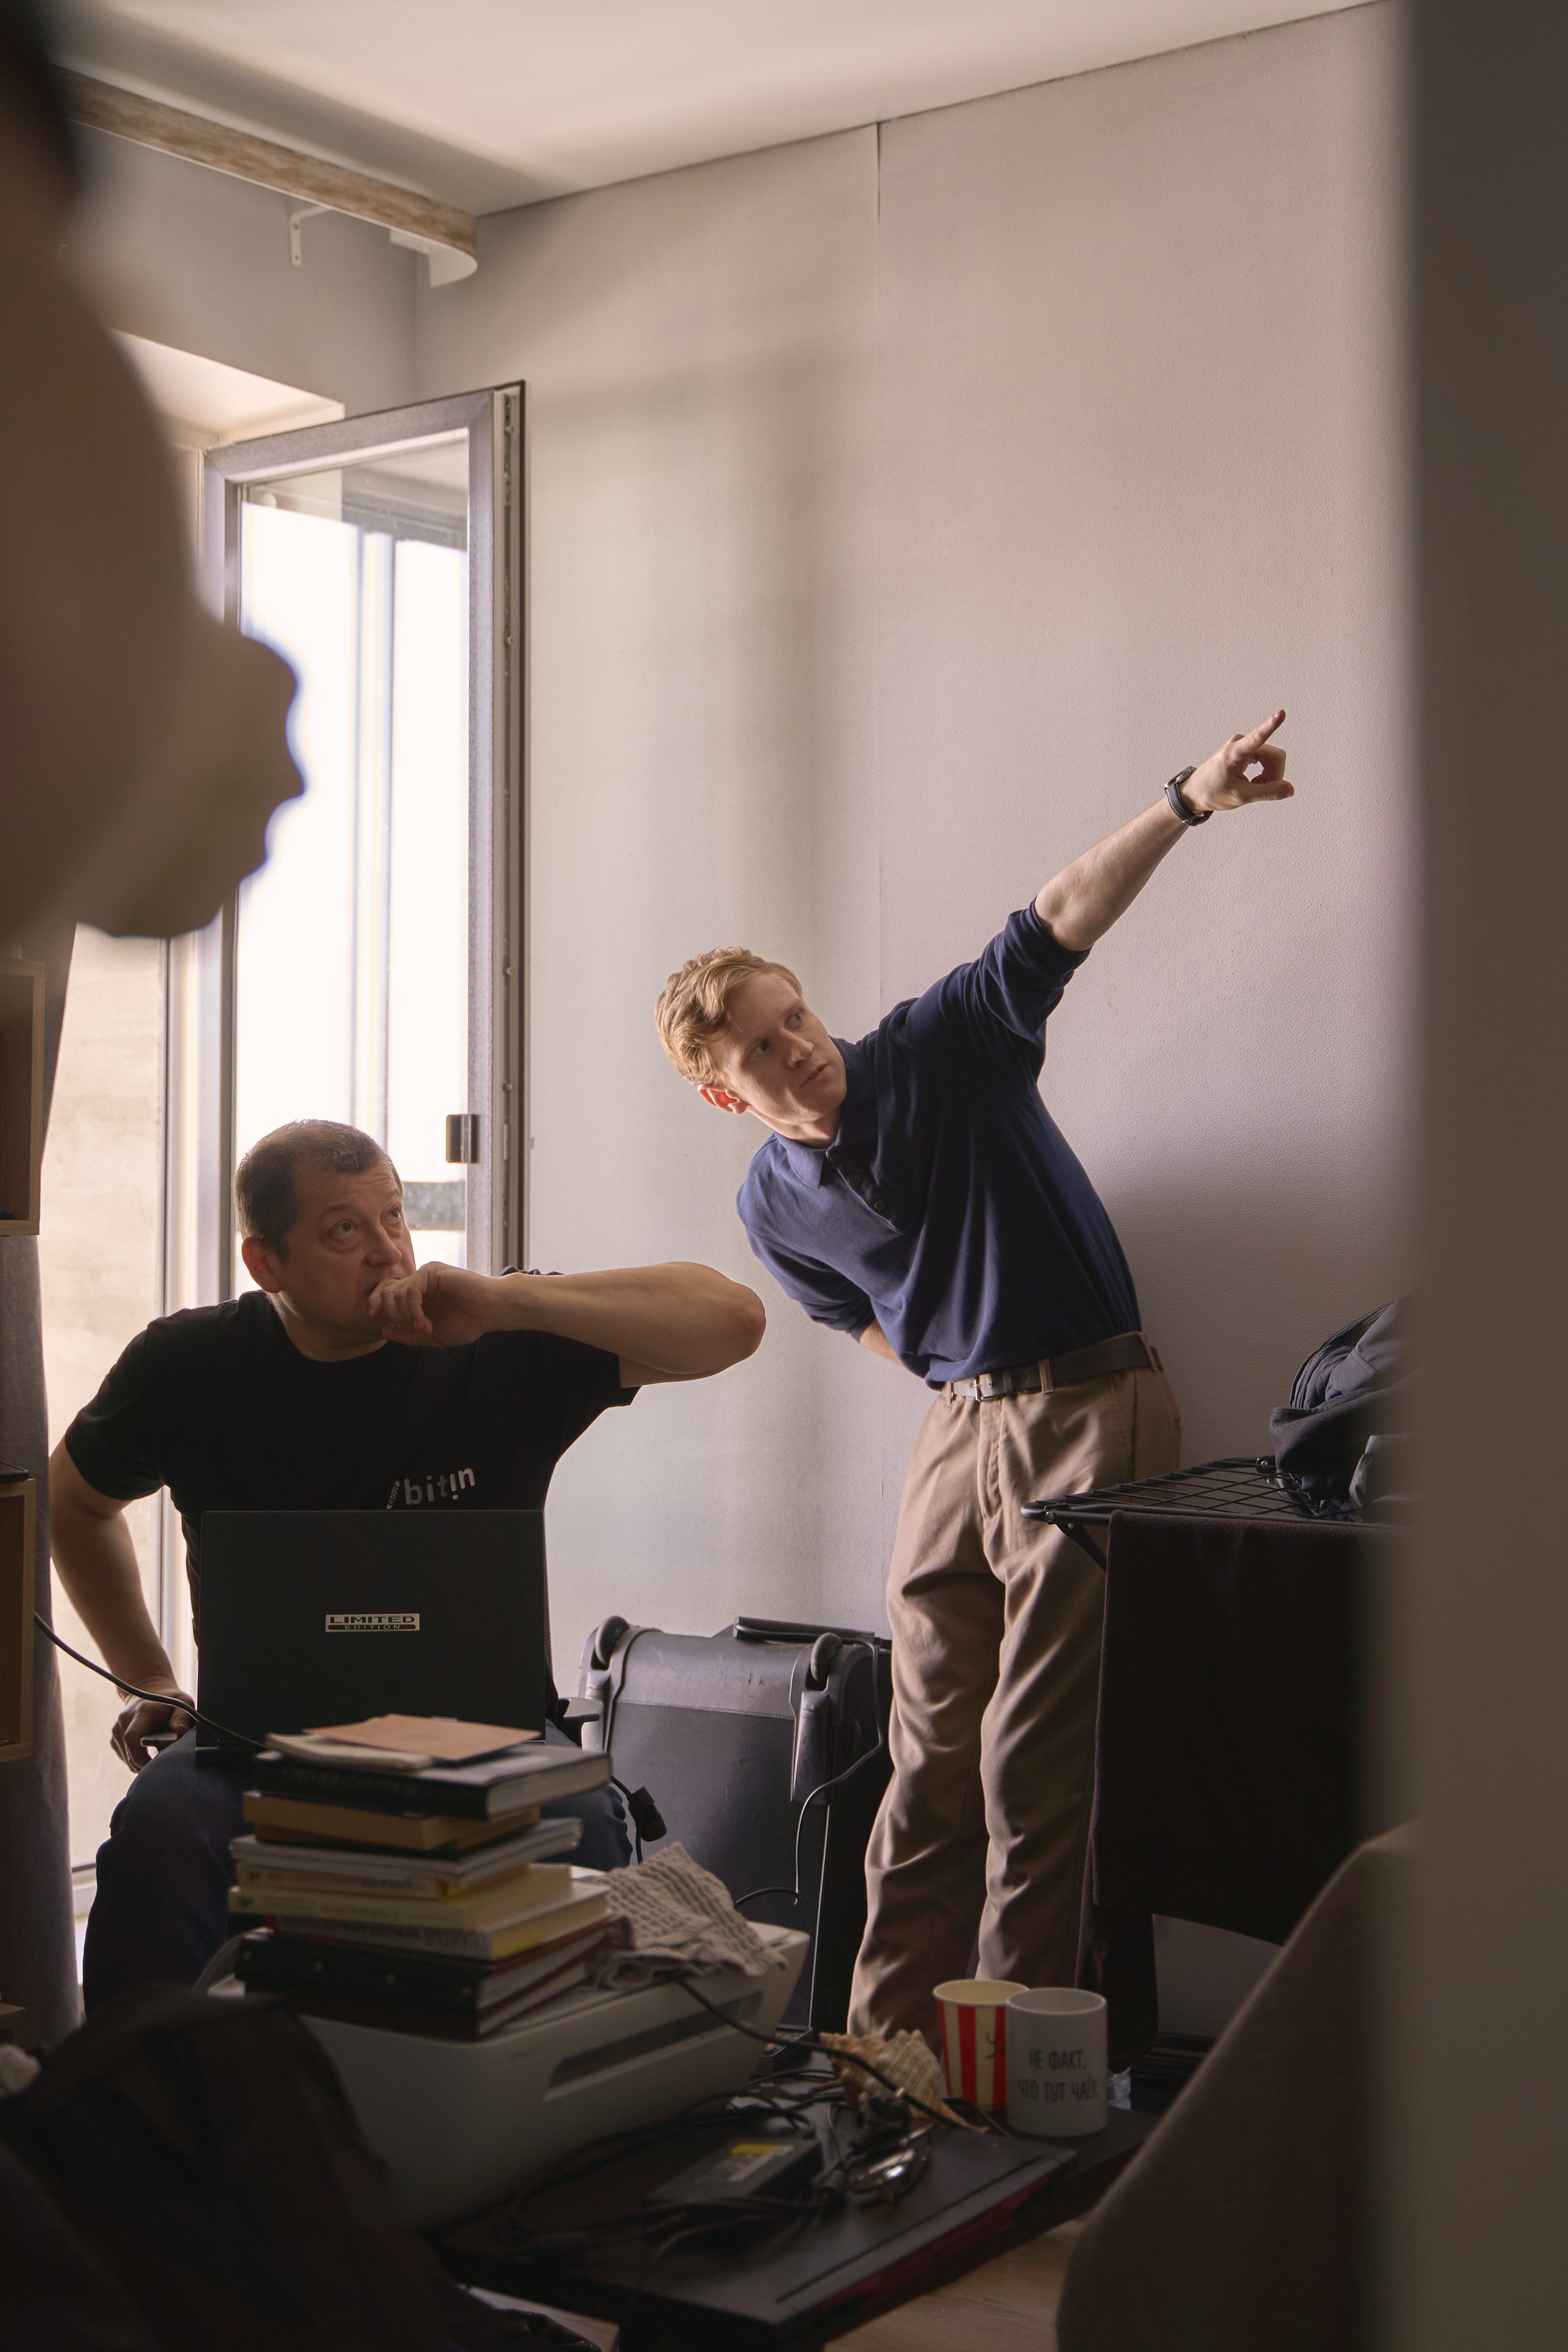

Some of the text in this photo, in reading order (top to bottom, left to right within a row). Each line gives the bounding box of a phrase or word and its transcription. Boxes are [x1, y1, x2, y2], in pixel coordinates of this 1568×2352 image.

[1029, 2050, 1042, 2070] НЕ
[1018, 2078, 1038, 2100] ЧТО
[1044, 2081, 1066, 2102] ТУТ
